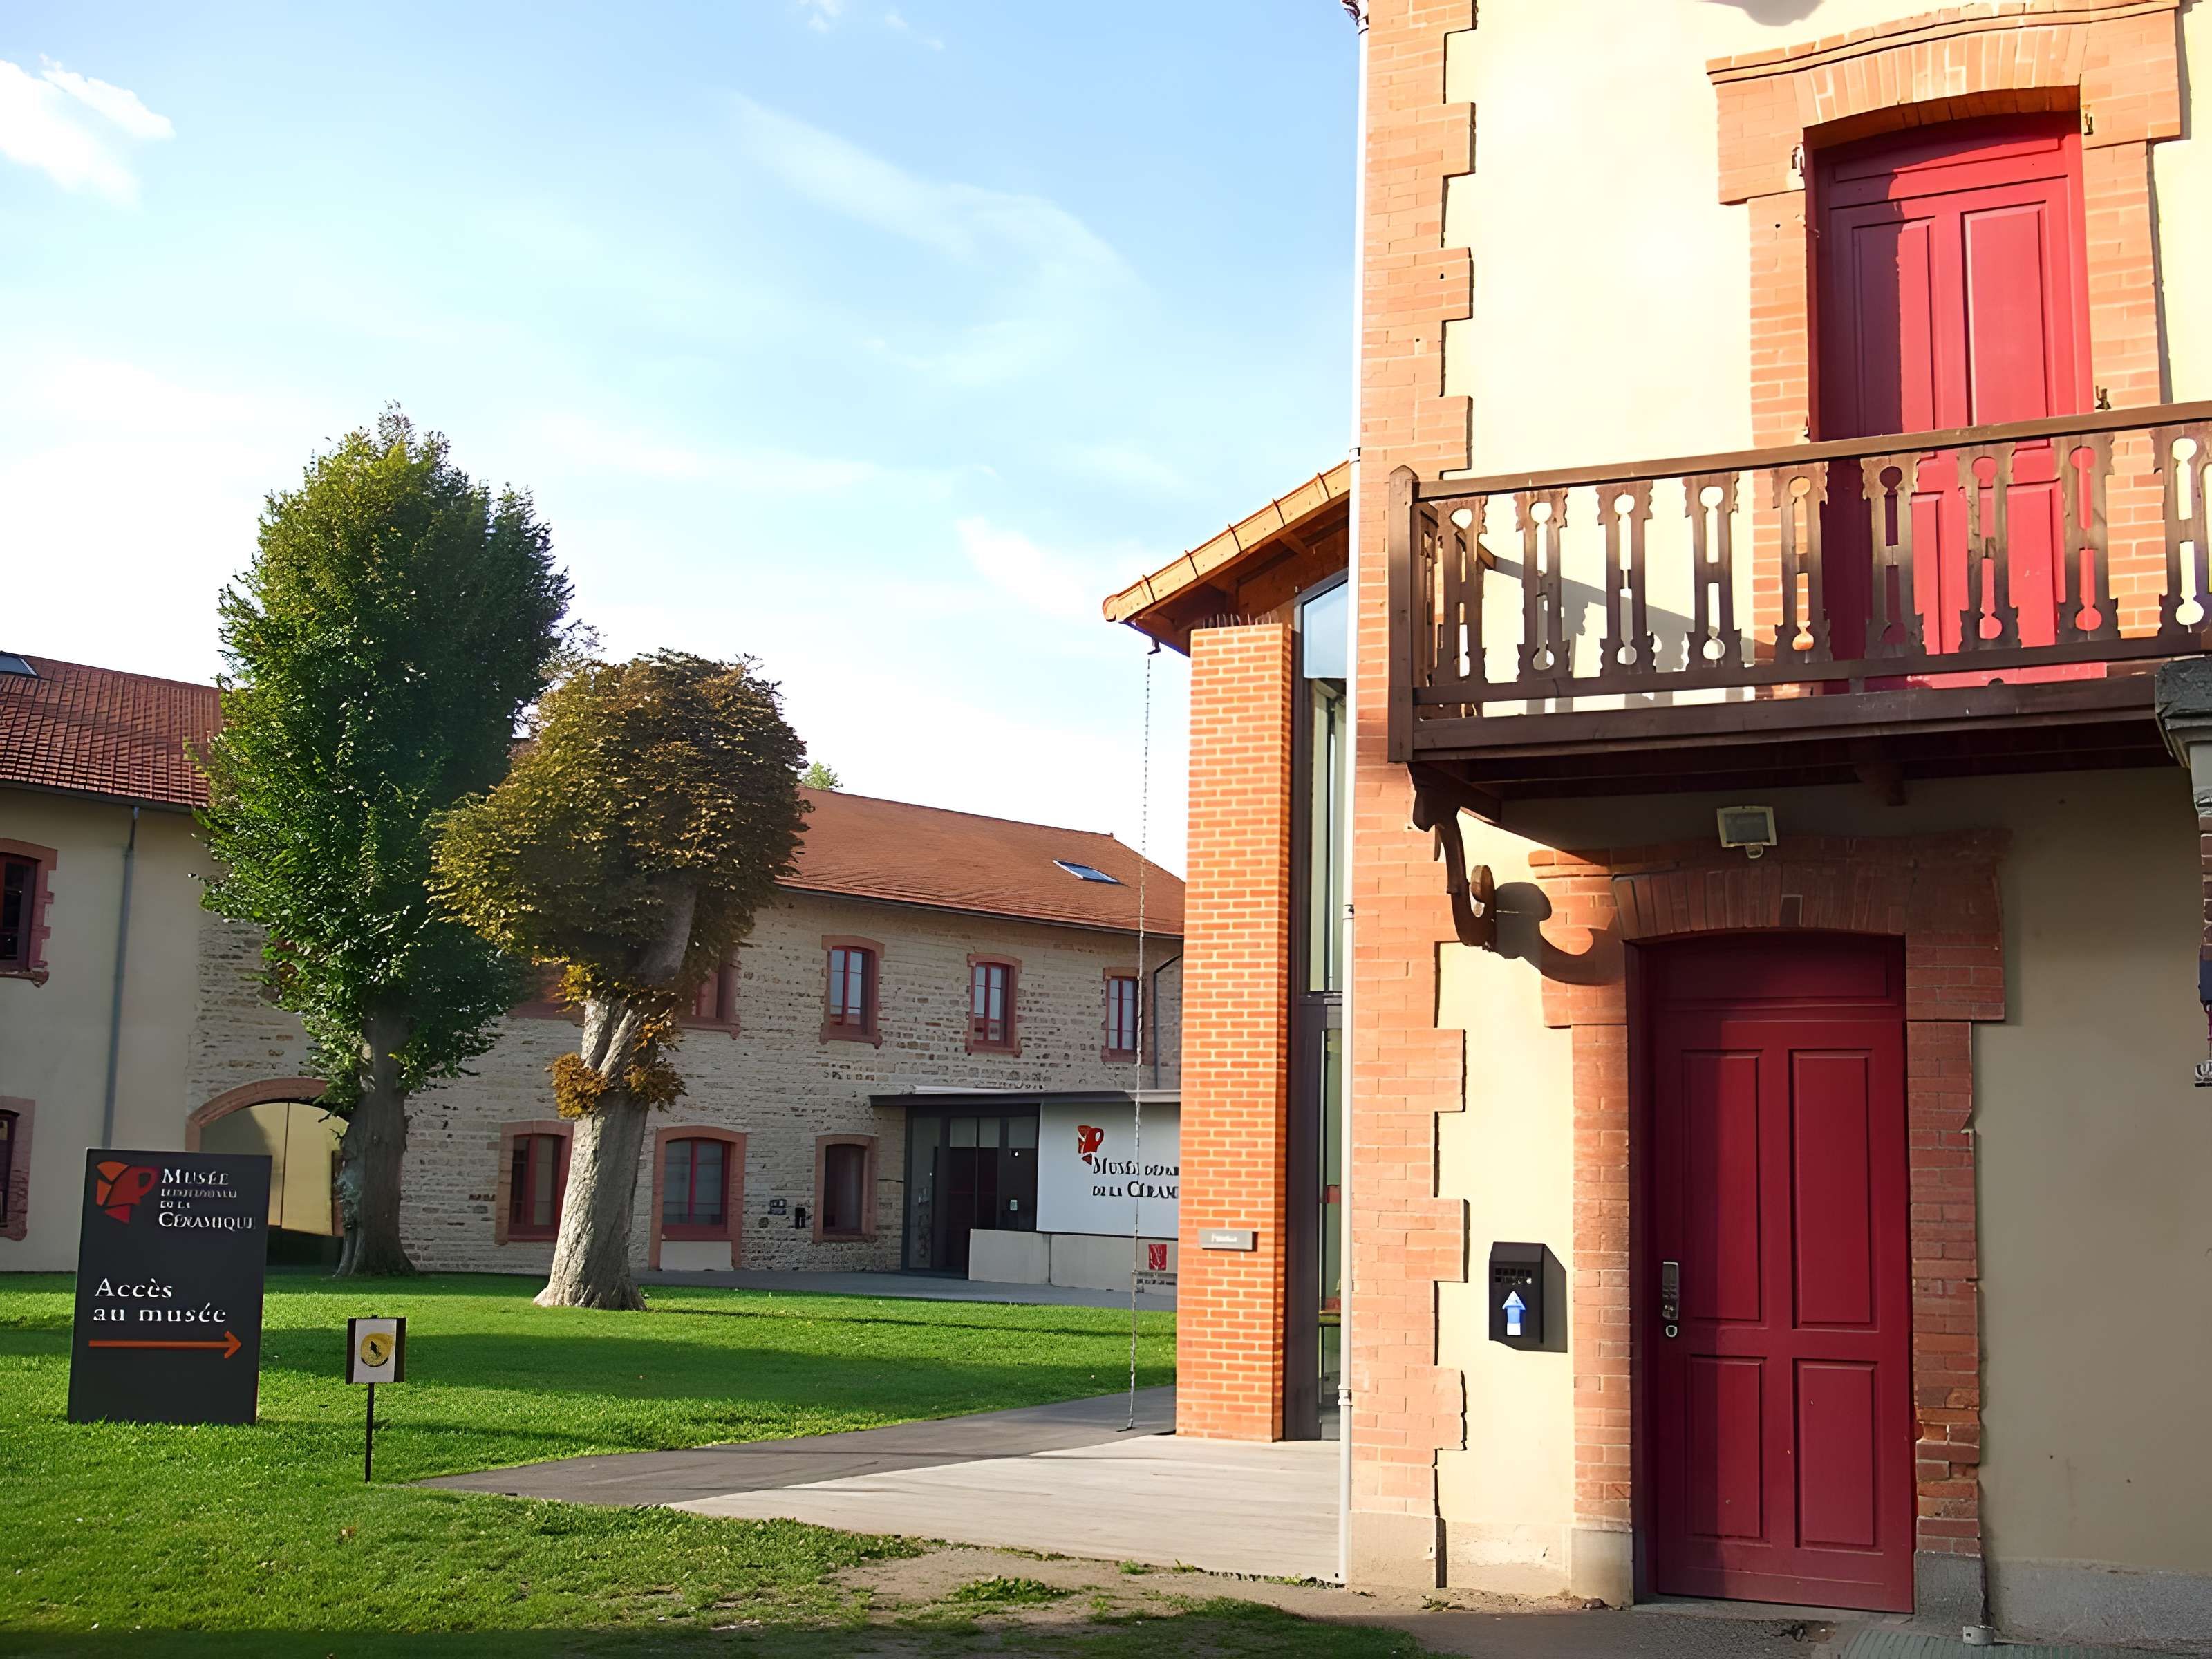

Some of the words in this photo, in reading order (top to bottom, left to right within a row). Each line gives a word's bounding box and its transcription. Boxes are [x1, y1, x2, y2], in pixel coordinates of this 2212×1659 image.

[95, 1277, 172, 1298] Accès
[93, 1309, 125, 1321] au
[139, 1302, 226, 1322] musée
